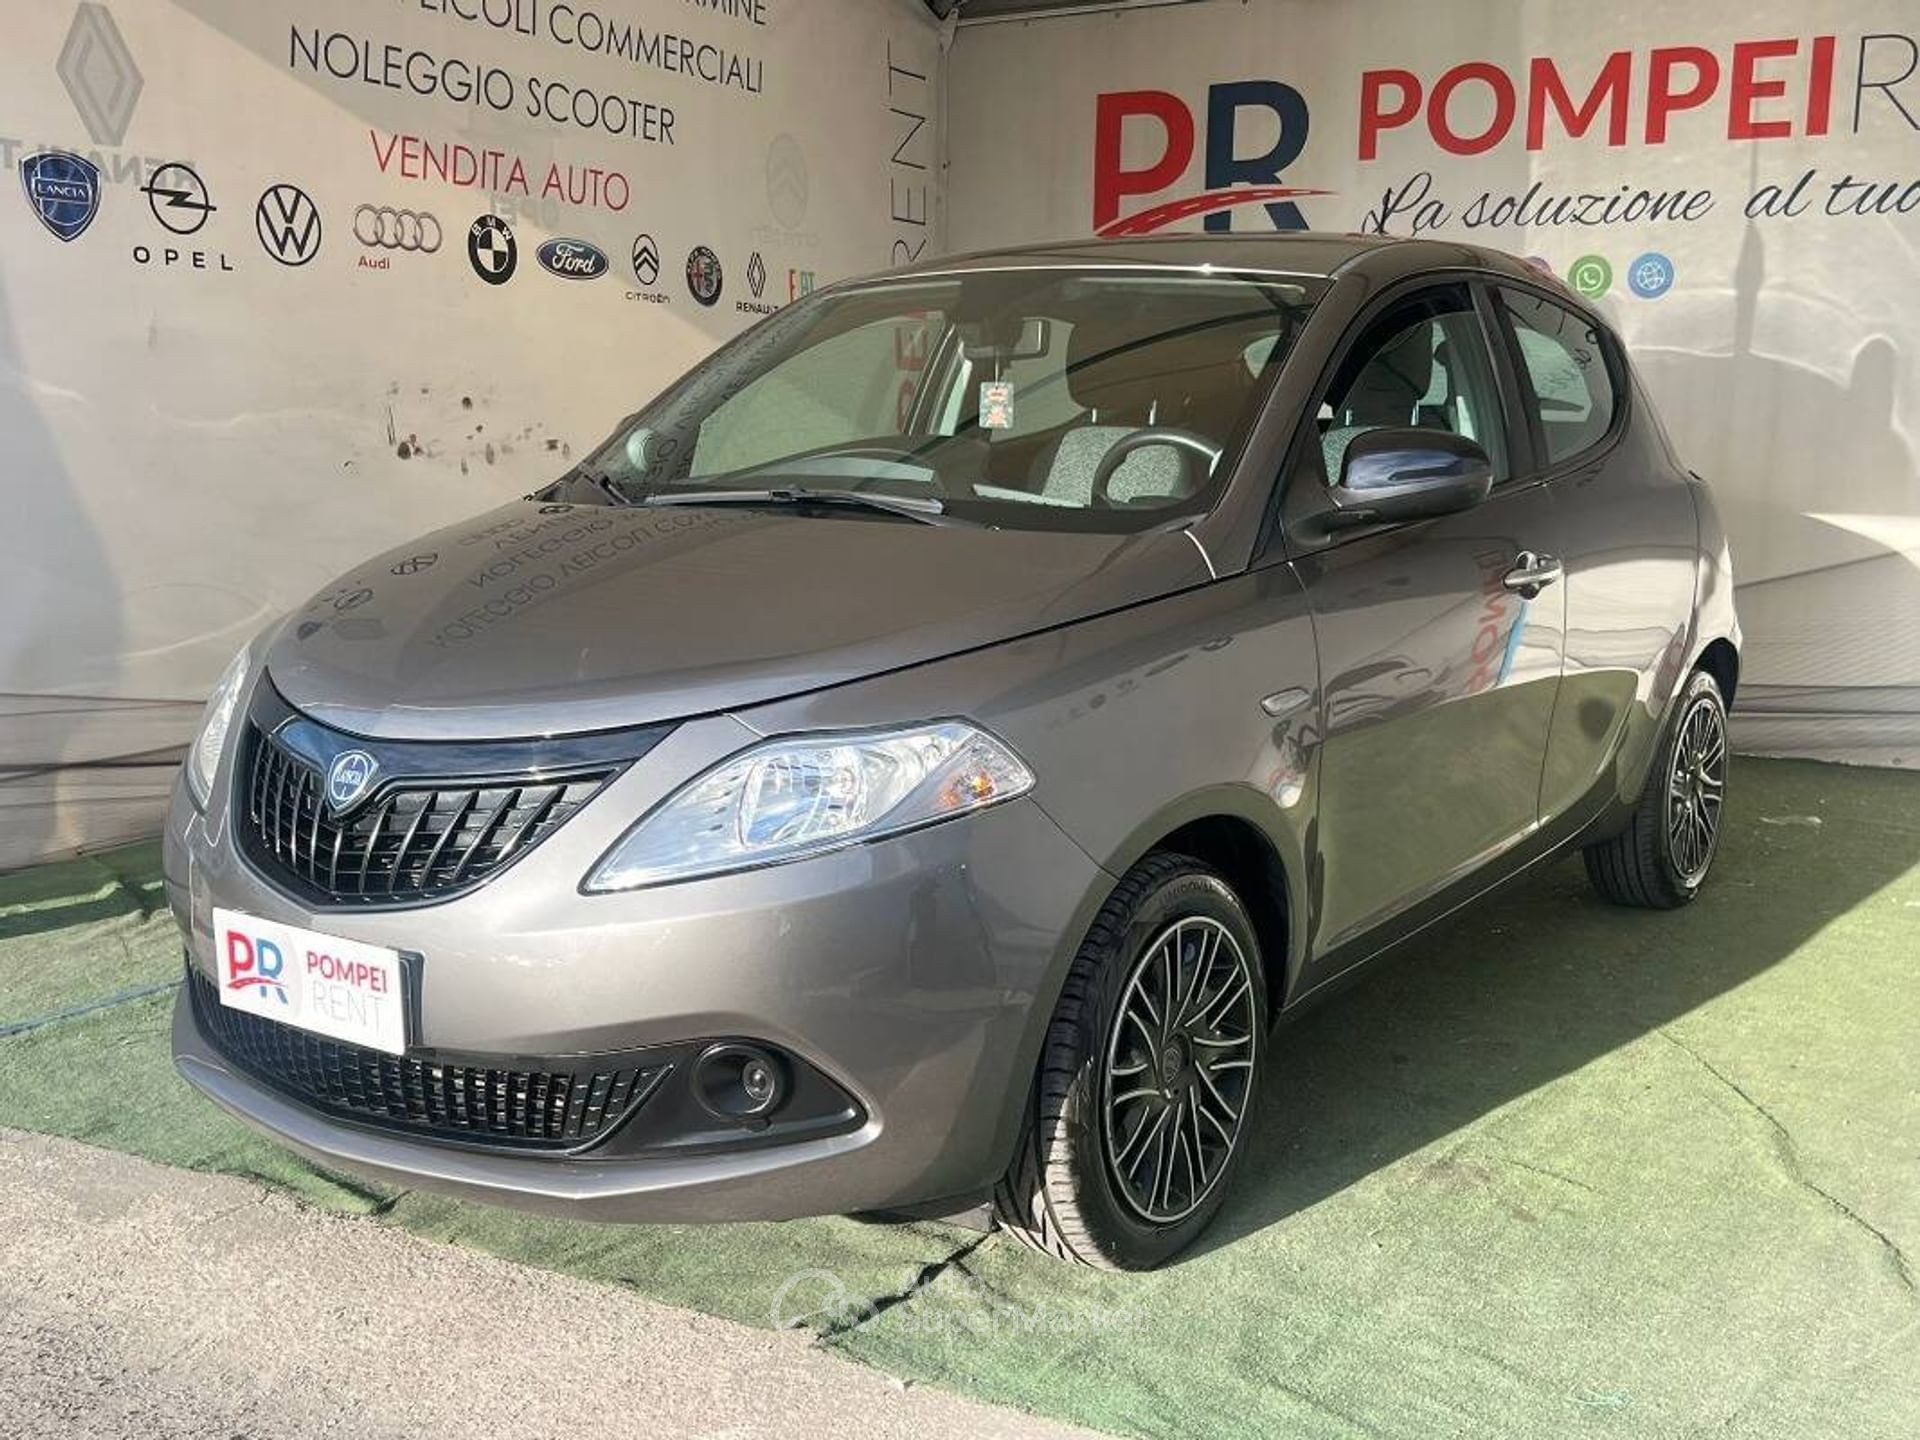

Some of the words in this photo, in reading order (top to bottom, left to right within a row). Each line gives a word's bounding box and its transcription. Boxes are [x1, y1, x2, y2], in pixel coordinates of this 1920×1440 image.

[549, 4, 763, 93] COMMERCIALI
[289, 25, 514, 111] NOLEGGIO
[526, 77, 675, 145] SCOOTER
[1357, 35, 1837, 162] POMPEI
[370, 130, 529, 196] VENDITA
[542, 163, 630, 211] AUTO
[887, 39, 928, 266] RENT
[1092, 80, 1311, 236] PR
[37, 182, 87, 199] LANCIA
[1361, 171, 1453, 237] La
[1462, 181, 1715, 229] soluzione
[1744, 168, 1815, 219] al
[133, 246, 233, 271] OPEL
[358, 255, 391, 270] Audi
[552, 243, 595, 274] Ford
[788, 268, 815, 303] FAT
[227, 930, 289, 1005] PR
[306, 950, 388, 993] POMPEI
[311, 980, 386, 1035] RENT
